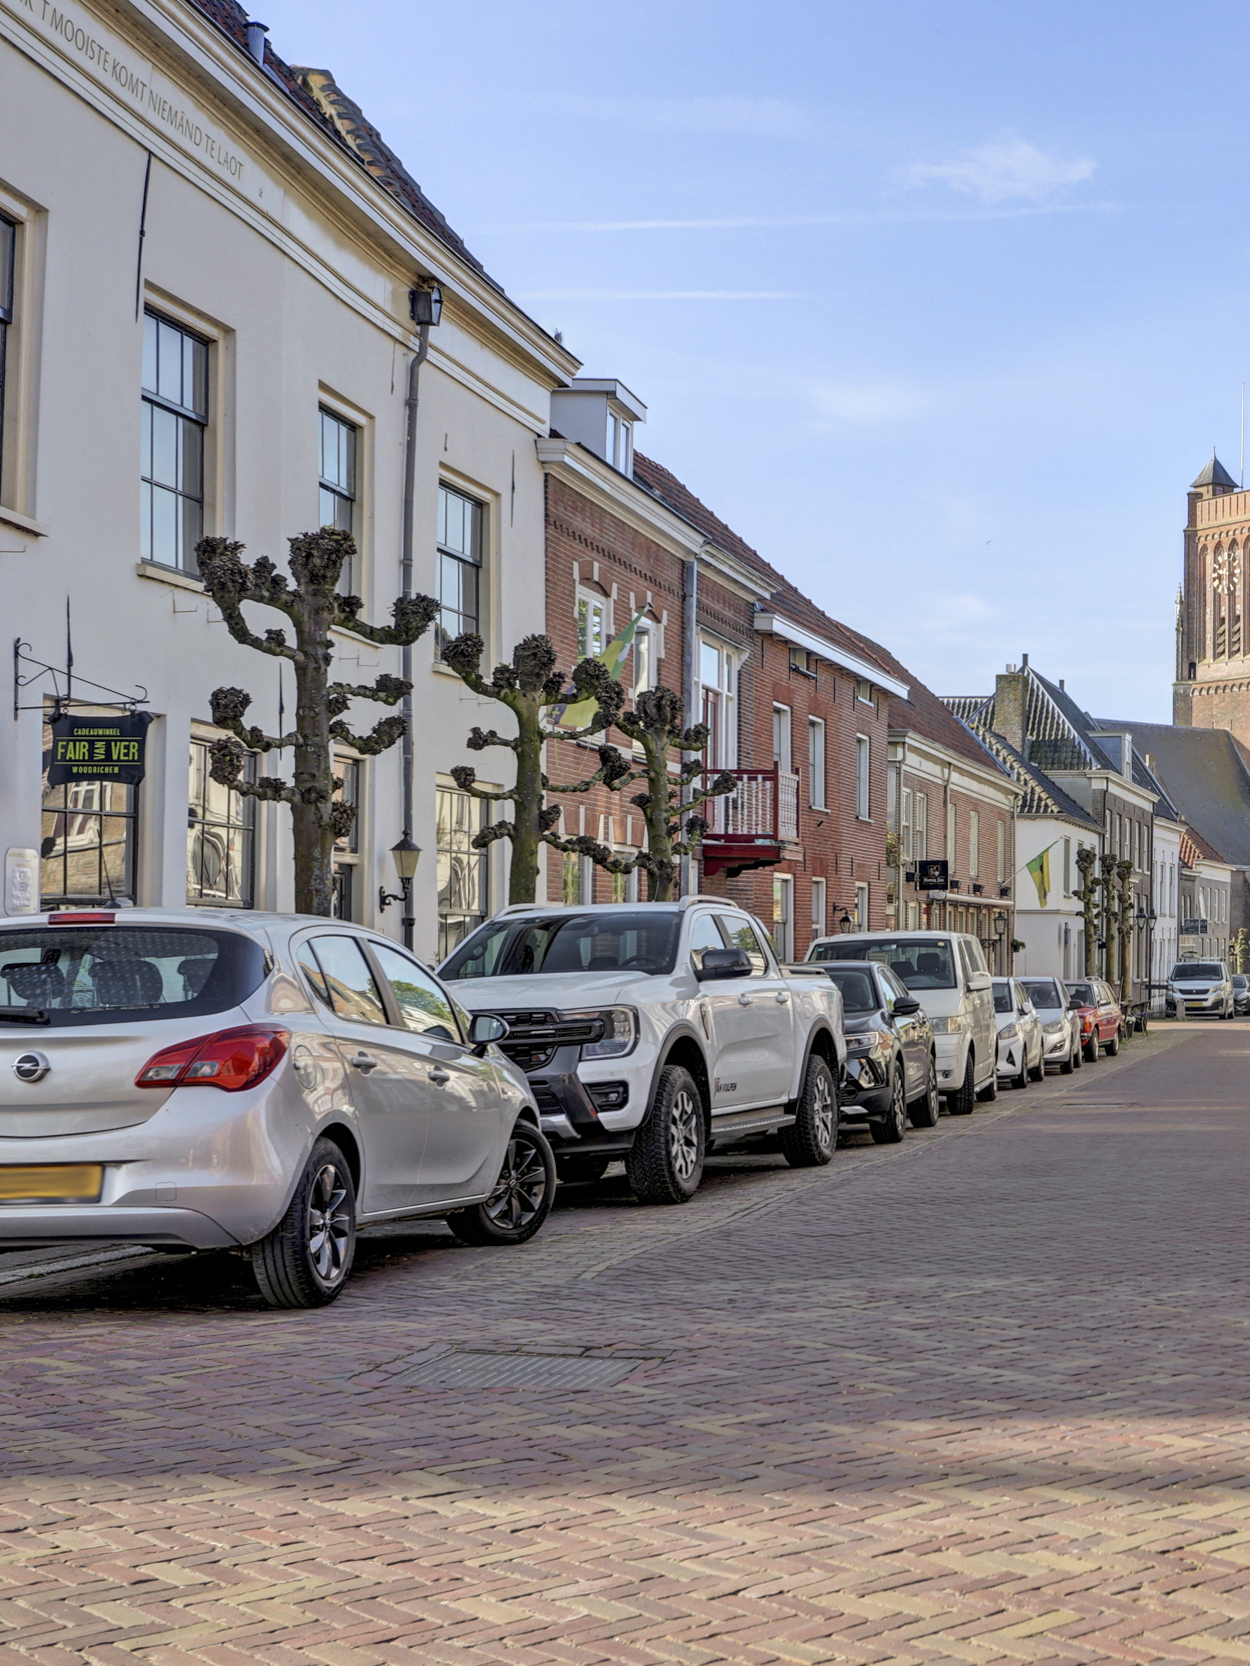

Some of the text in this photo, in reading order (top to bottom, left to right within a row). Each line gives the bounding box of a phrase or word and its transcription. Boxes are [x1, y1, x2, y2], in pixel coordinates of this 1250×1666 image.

[50, 7, 110, 73] MOOISTE
[111, 58, 147, 102] KOMT
[148, 89, 203, 147] NIEMÂND
[204, 133, 216, 159] TE
[217, 145, 244, 180] LAOT
[73, 728, 121, 736] CADEAUWINKEL
[57, 741, 139, 760] FAIR VAN VER
[72, 766, 119, 774] WOUDRICHEM
